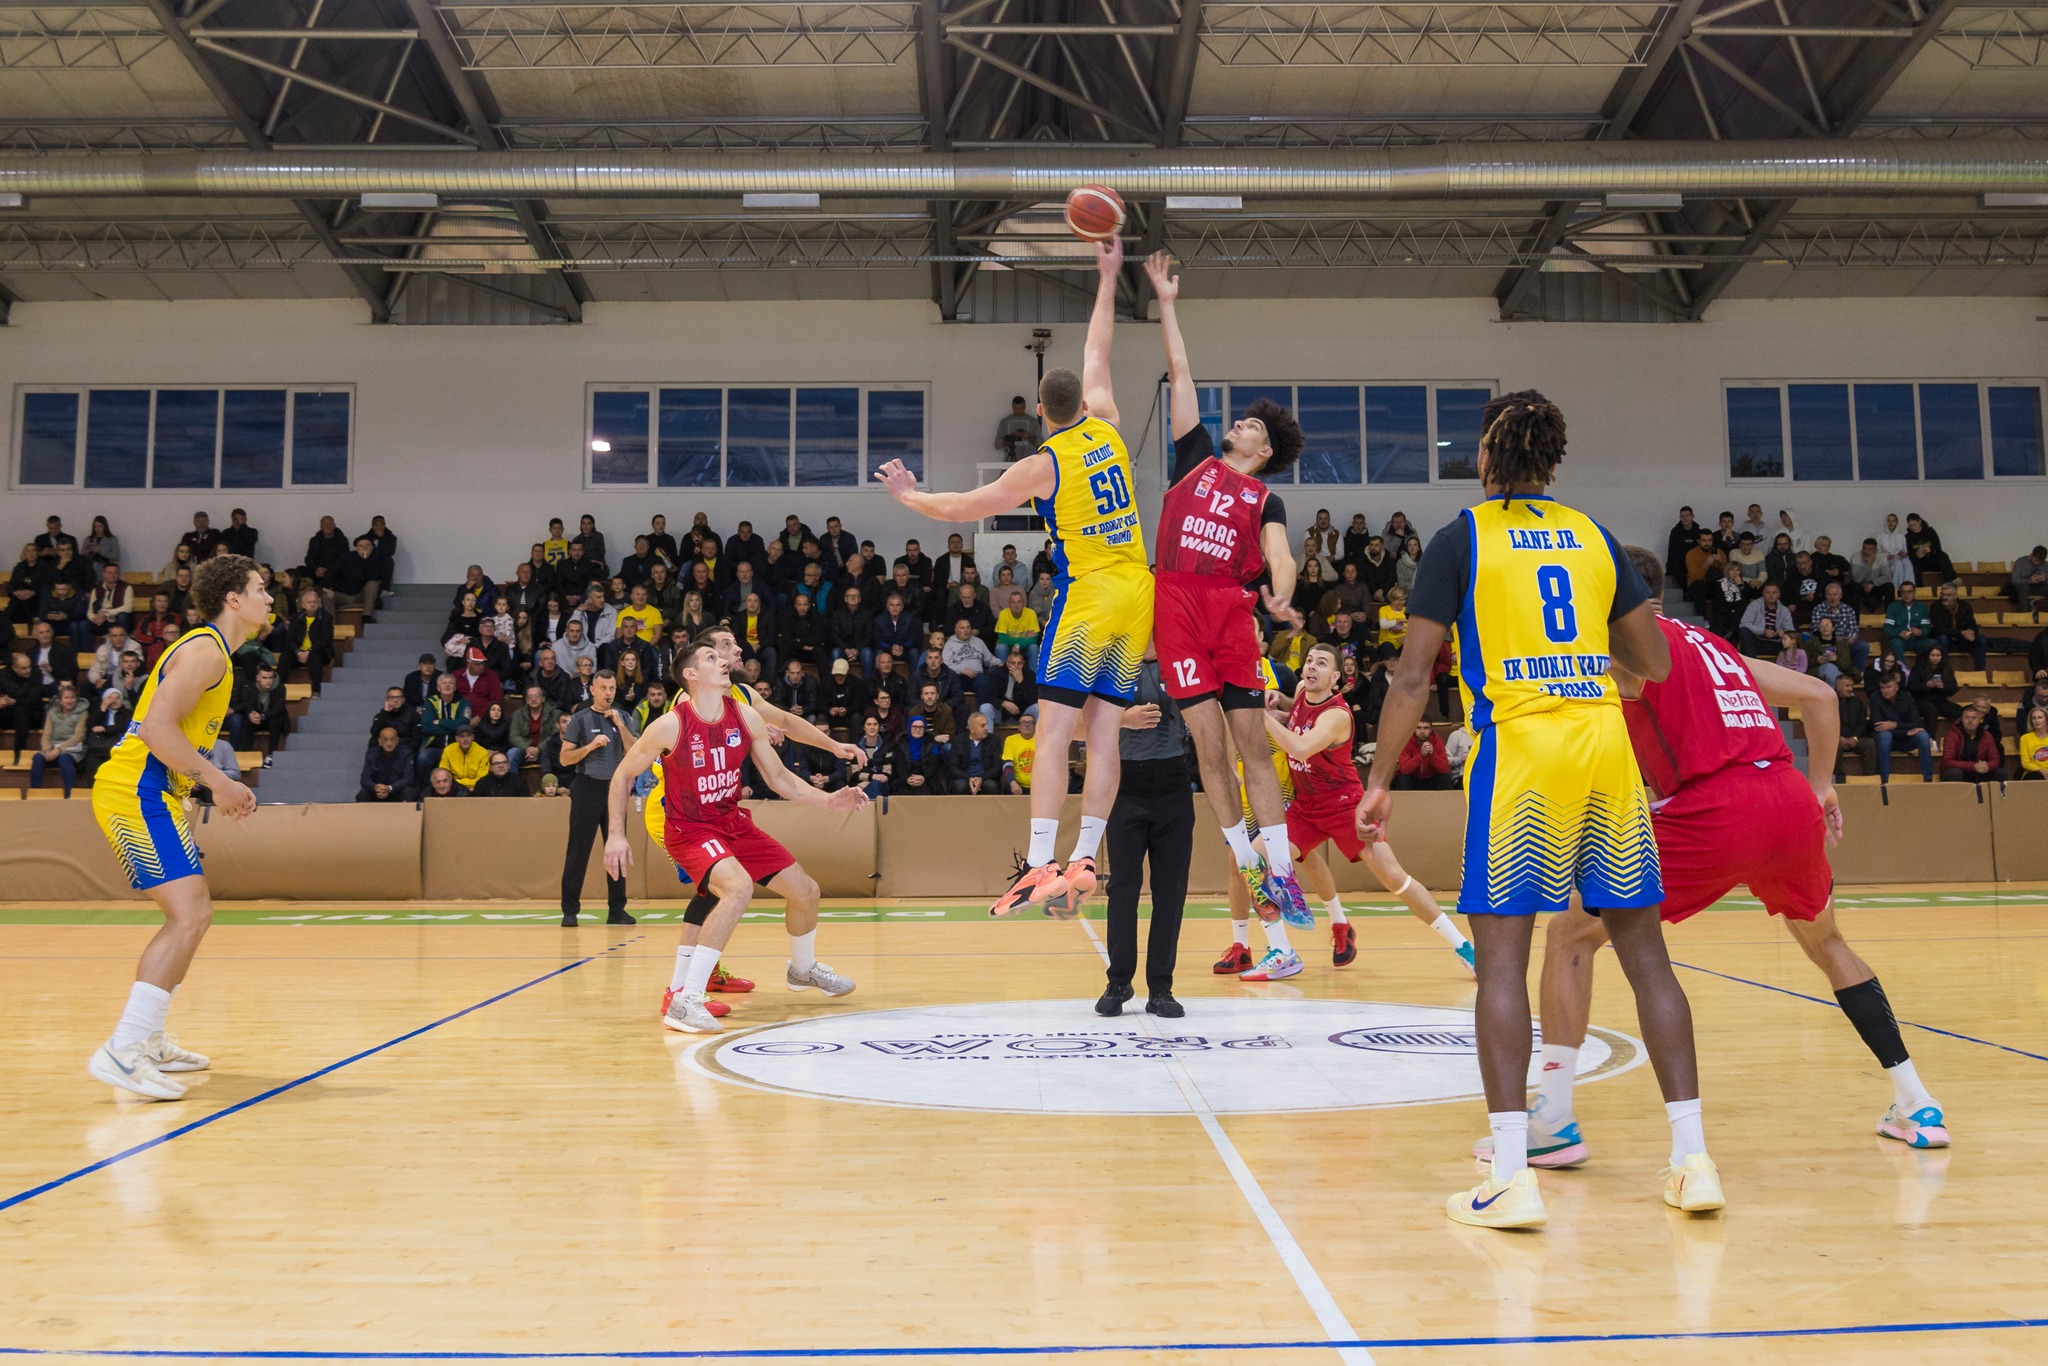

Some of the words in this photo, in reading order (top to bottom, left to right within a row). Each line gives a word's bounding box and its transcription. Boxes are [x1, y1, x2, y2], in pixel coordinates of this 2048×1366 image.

[1088, 464, 1130, 515] 50
[1208, 490, 1235, 518] 12
[1181, 515, 1238, 547] BORAC
[1507, 529, 1553, 549] LANE
[1556, 529, 1583, 549] JR.
[1537, 565, 1578, 643] 8
[1525, 655, 1575, 680] DONJI
[1684, 630, 1751, 687] 14
[1172, 658, 1201, 688] 12
[710, 746, 726, 771] 11
[697, 768, 740, 792] BORAC
[701, 839, 726, 858] 11
[732, 1035, 1293, 1056] PROMO
